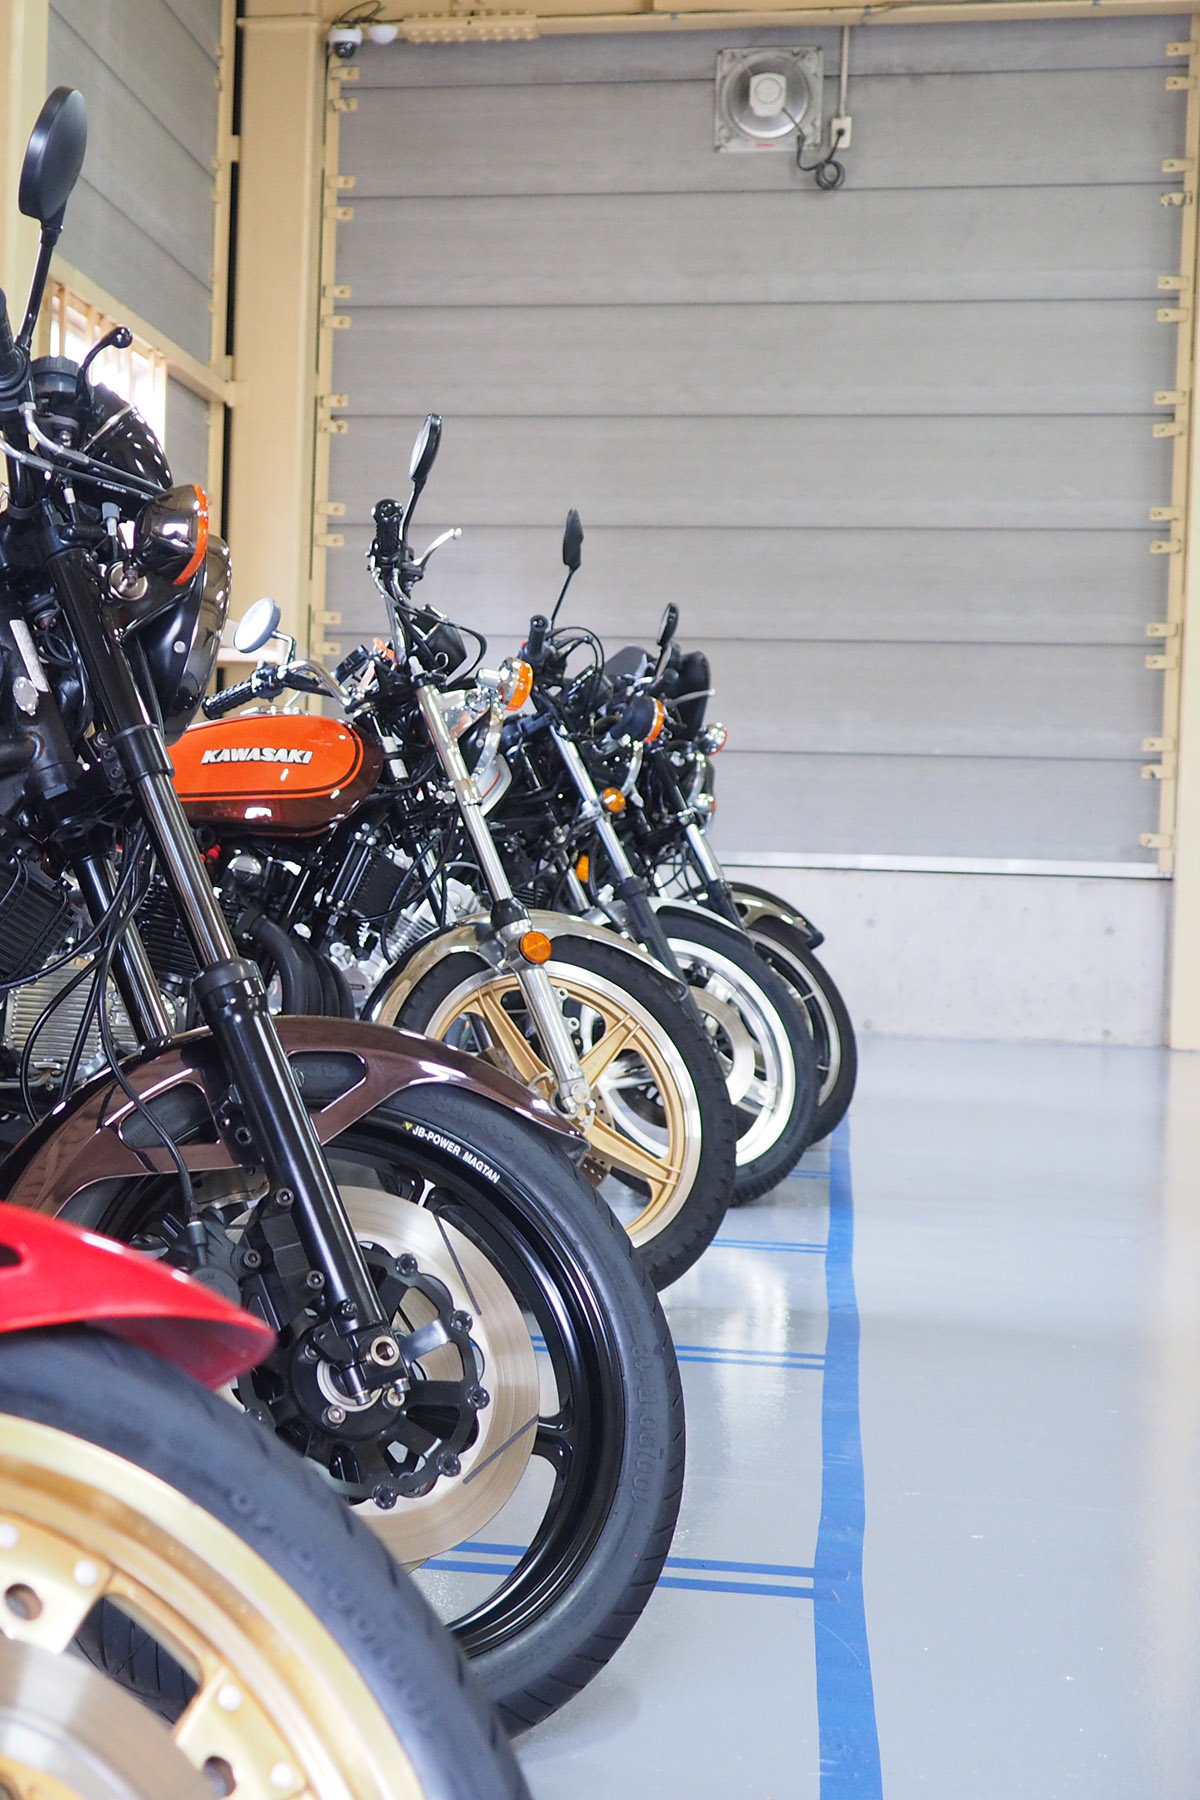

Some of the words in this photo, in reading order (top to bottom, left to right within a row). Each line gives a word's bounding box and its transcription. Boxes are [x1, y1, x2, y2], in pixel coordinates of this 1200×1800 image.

[201, 747, 313, 764] KAWASAKI
[412, 1125, 461, 1157] JB-POWER
[462, 1151, 501, 1184] MAGTAN
